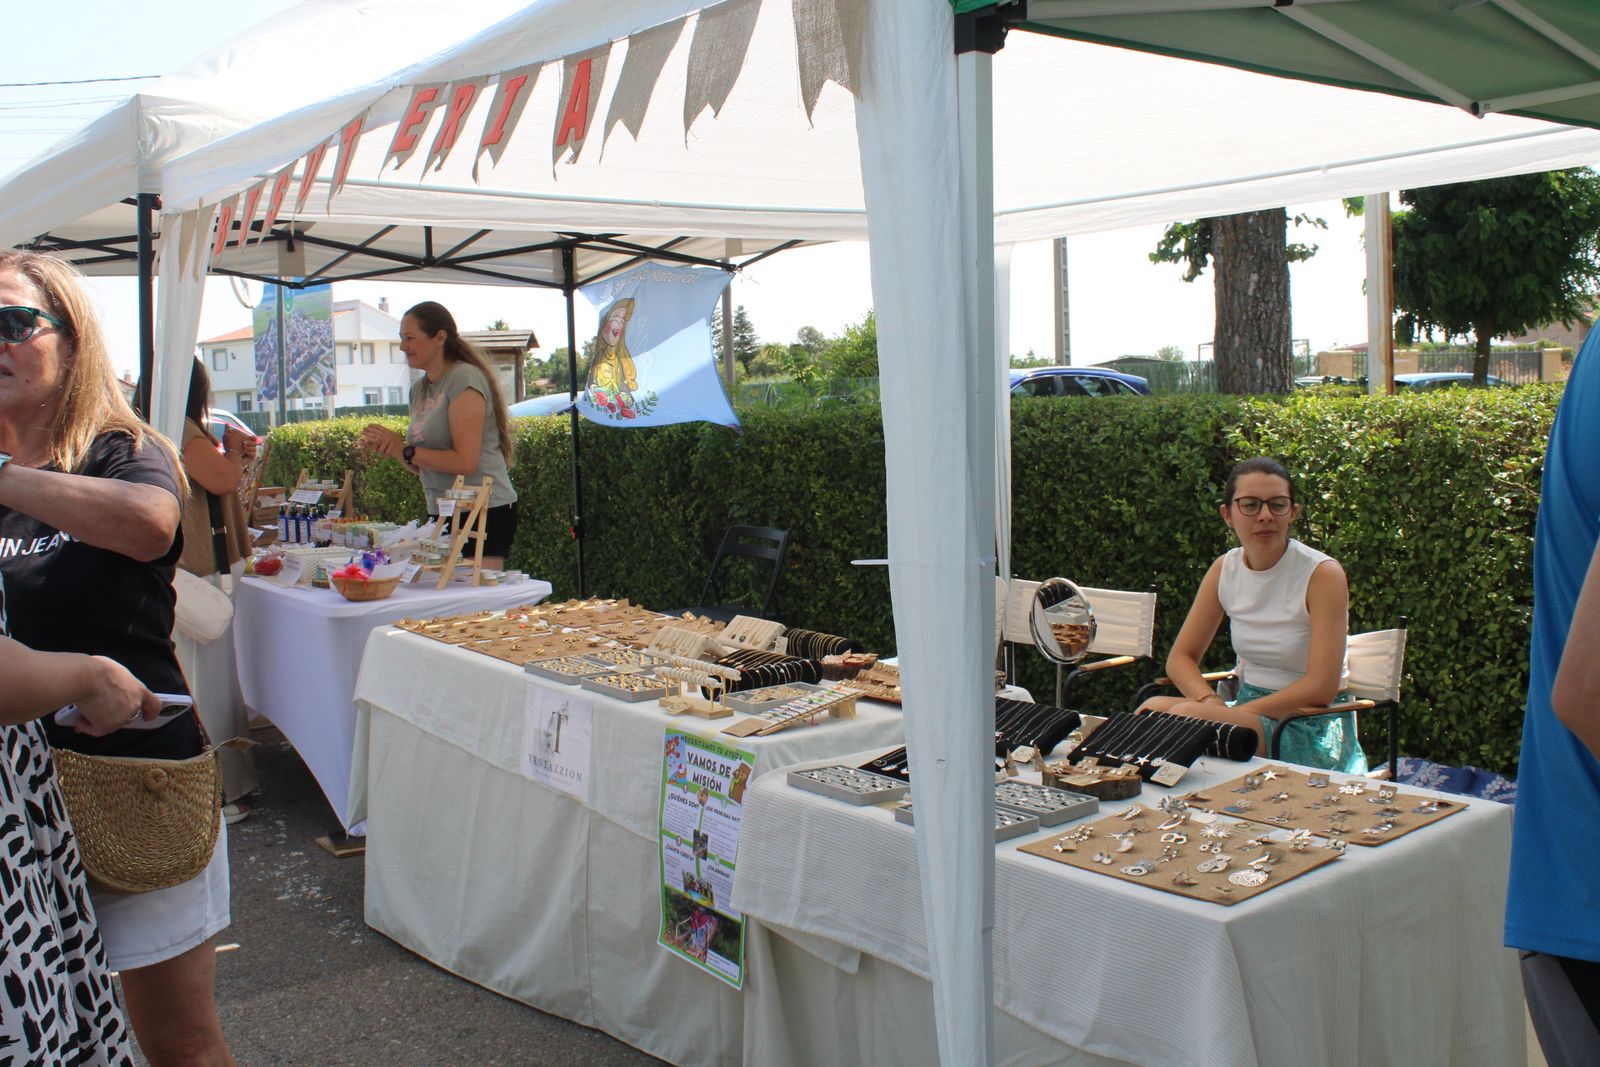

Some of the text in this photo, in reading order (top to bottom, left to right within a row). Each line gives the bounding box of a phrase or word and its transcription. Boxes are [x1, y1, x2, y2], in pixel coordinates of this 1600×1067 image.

[214, 58, 592, 256] BISUTERIA
[528, 754, 583, 783] TENTAZZION
[687, 751, 732, 778] VAMOS DE
[692, 771, 722, 793] MISIÓN
